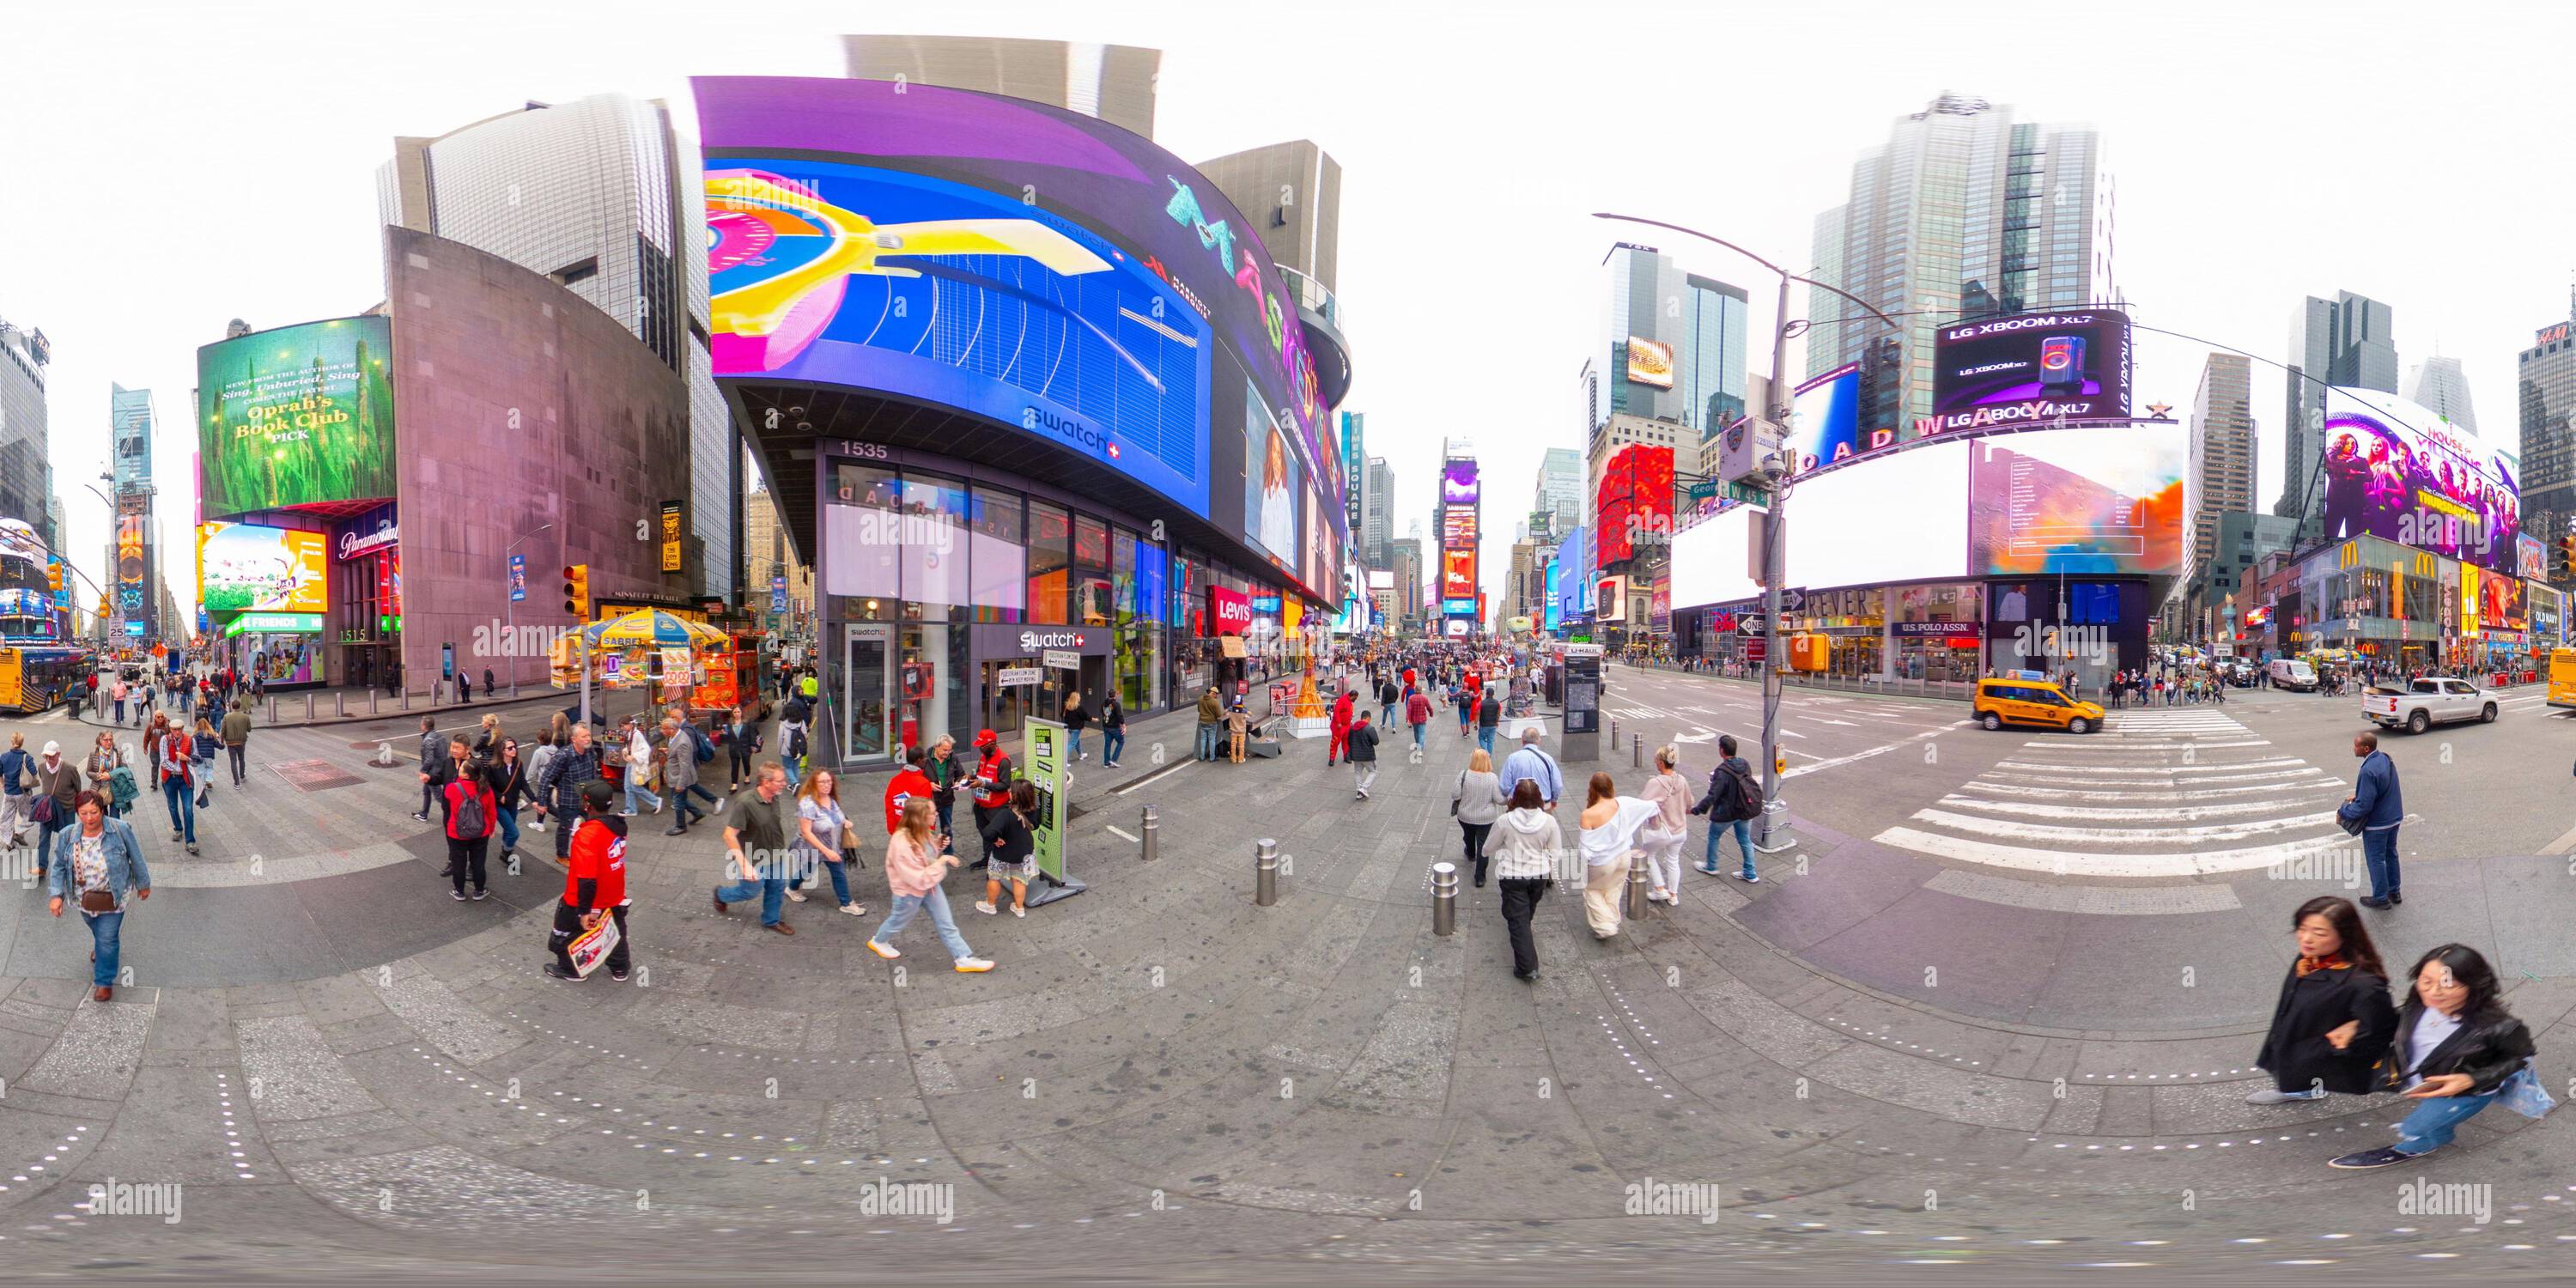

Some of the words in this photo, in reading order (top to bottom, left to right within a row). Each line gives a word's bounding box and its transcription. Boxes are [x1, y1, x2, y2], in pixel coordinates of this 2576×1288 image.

[1171, 283, 1208, 320] MARQUIS
[1173, 275, 1212, 316] MARRIOTT
[1949, 328, 1974, 340] LG
[1979, 316, 2056, 335] XBOOM
[2061, 315, 2093, 325] XL7
[248, 374, 274, 383] FROM
[298, 364, 339, 375] AUTHOR
[1975, 361, 2014, 374] XBOOM
[328, 372, 360, 382] Sing
[243, 394, 275, 404] COMES
[301, 385, 336, 395] LATEST
[247, 396, 332, 419] Oprah's
[1947, 413, 1972, 428] LG
[2058, 403, 2090, 415] XL7
[235, 417, 289, 439] Book
[295, 409, 349, 428] Club
[1028, 405, 1109, 452] swatch
[271, 429, 309, 444] PICK
[1351, 419, 1360, 459] TIMES
[2427, 426, 2463, 453] HOUSE
[841, 440, 888, 459] 1535
[1350, 465, 1360, 520] SQUARE
[1693, 484, 1718, 494] Geor
[1731, 485, 1741, 498] W
[1746, 492, 1757, 503] 45
[1760, 493, 1767, 501] St
[339, 523, 398, 559] Paramount
[1783, 596, 1798, 605] WAY
[252, 617, 297, 628] FRIENDS
[1746, 621, 1763, 631] ONE
[2536, 611, 2545, 623] OLD
[2545, 612, 2558, 624] NAVY
[110, 628, 124, 637] 25
[339, 629, 366, 641] 1515
[851, 628, 880, 636] swatch
[1902, 623, 1917, 632] U.S.
[1917, 623, 1941, 632] POLO
[1942, 623, 1970, 632] ASSN.
[1020, 632, 1075, 647] swatch
